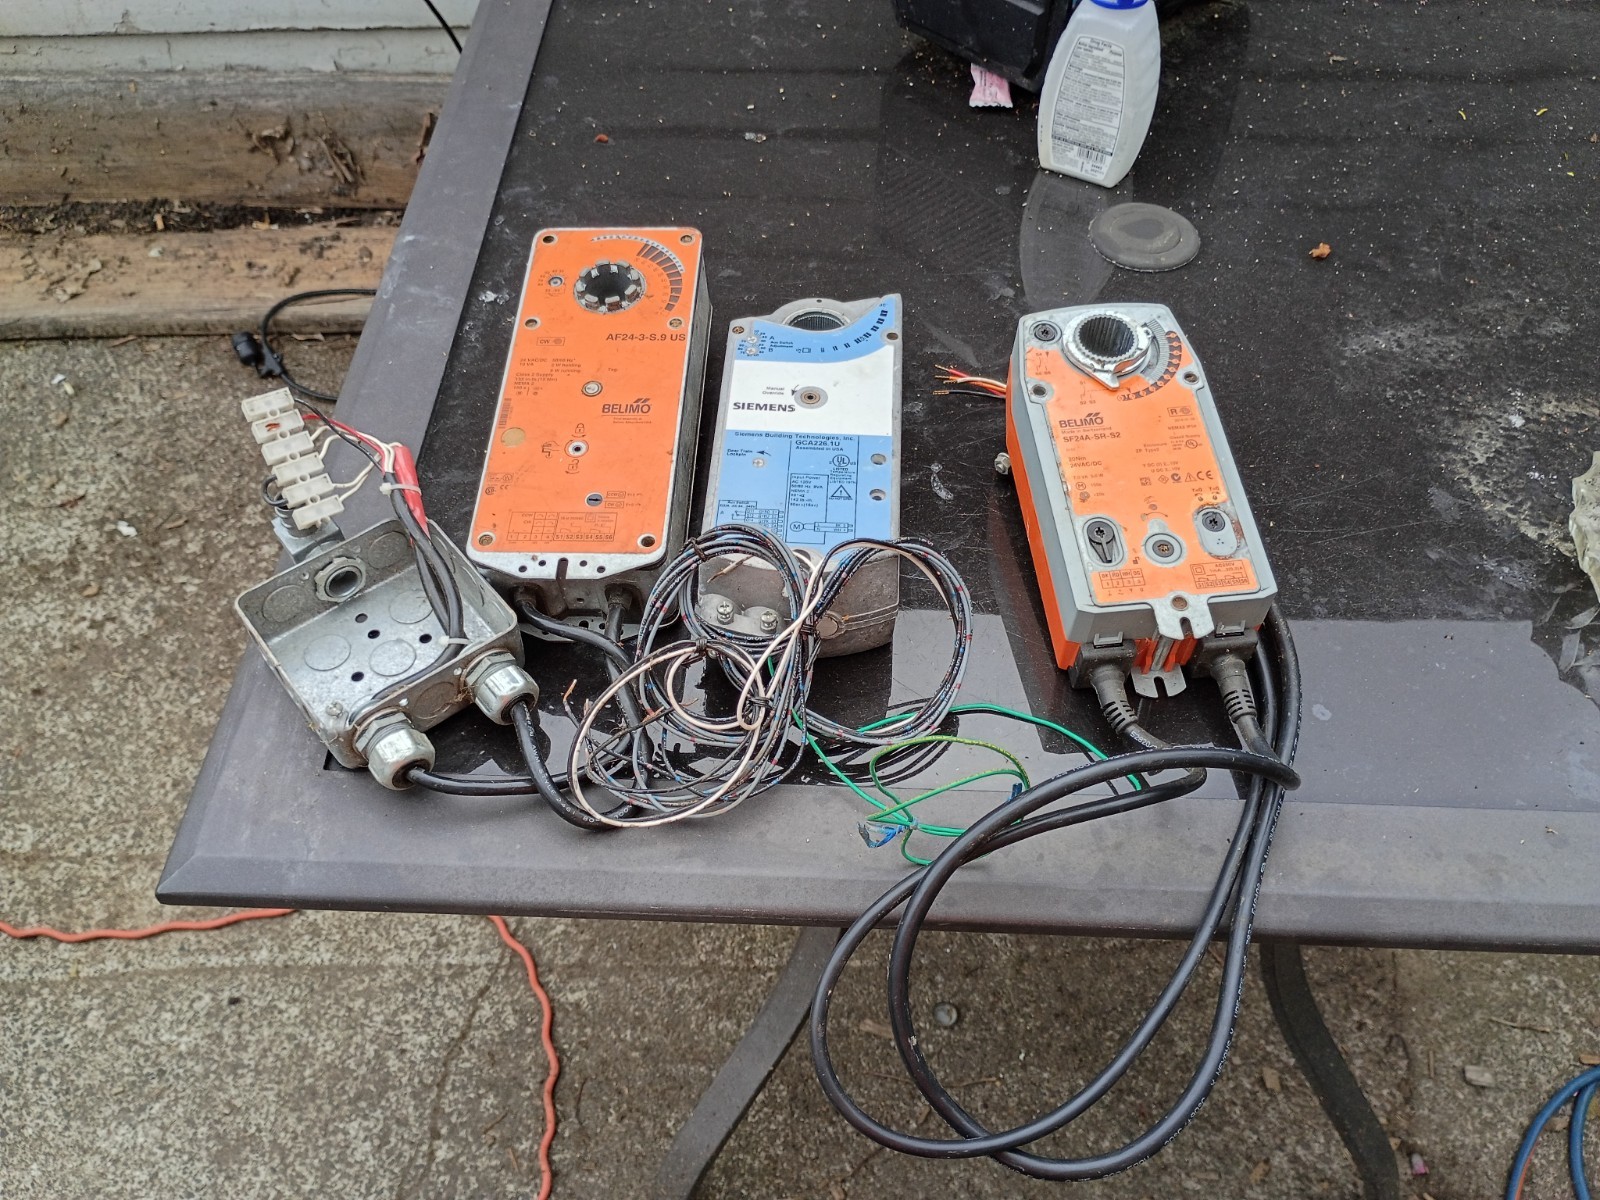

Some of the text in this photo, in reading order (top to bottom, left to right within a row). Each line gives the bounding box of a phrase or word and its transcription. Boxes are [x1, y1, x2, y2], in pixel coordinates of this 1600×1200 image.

[606, 333, 686, 341] AF24-3-S.9 US
[602, 403, 651, 414] BELIMO
[733, 402, 796, 412] SIEMENS
[1059, 417, 1104, 428] BELIMO
[1063, 432, 1121, 442] SF24A-SR-S2
